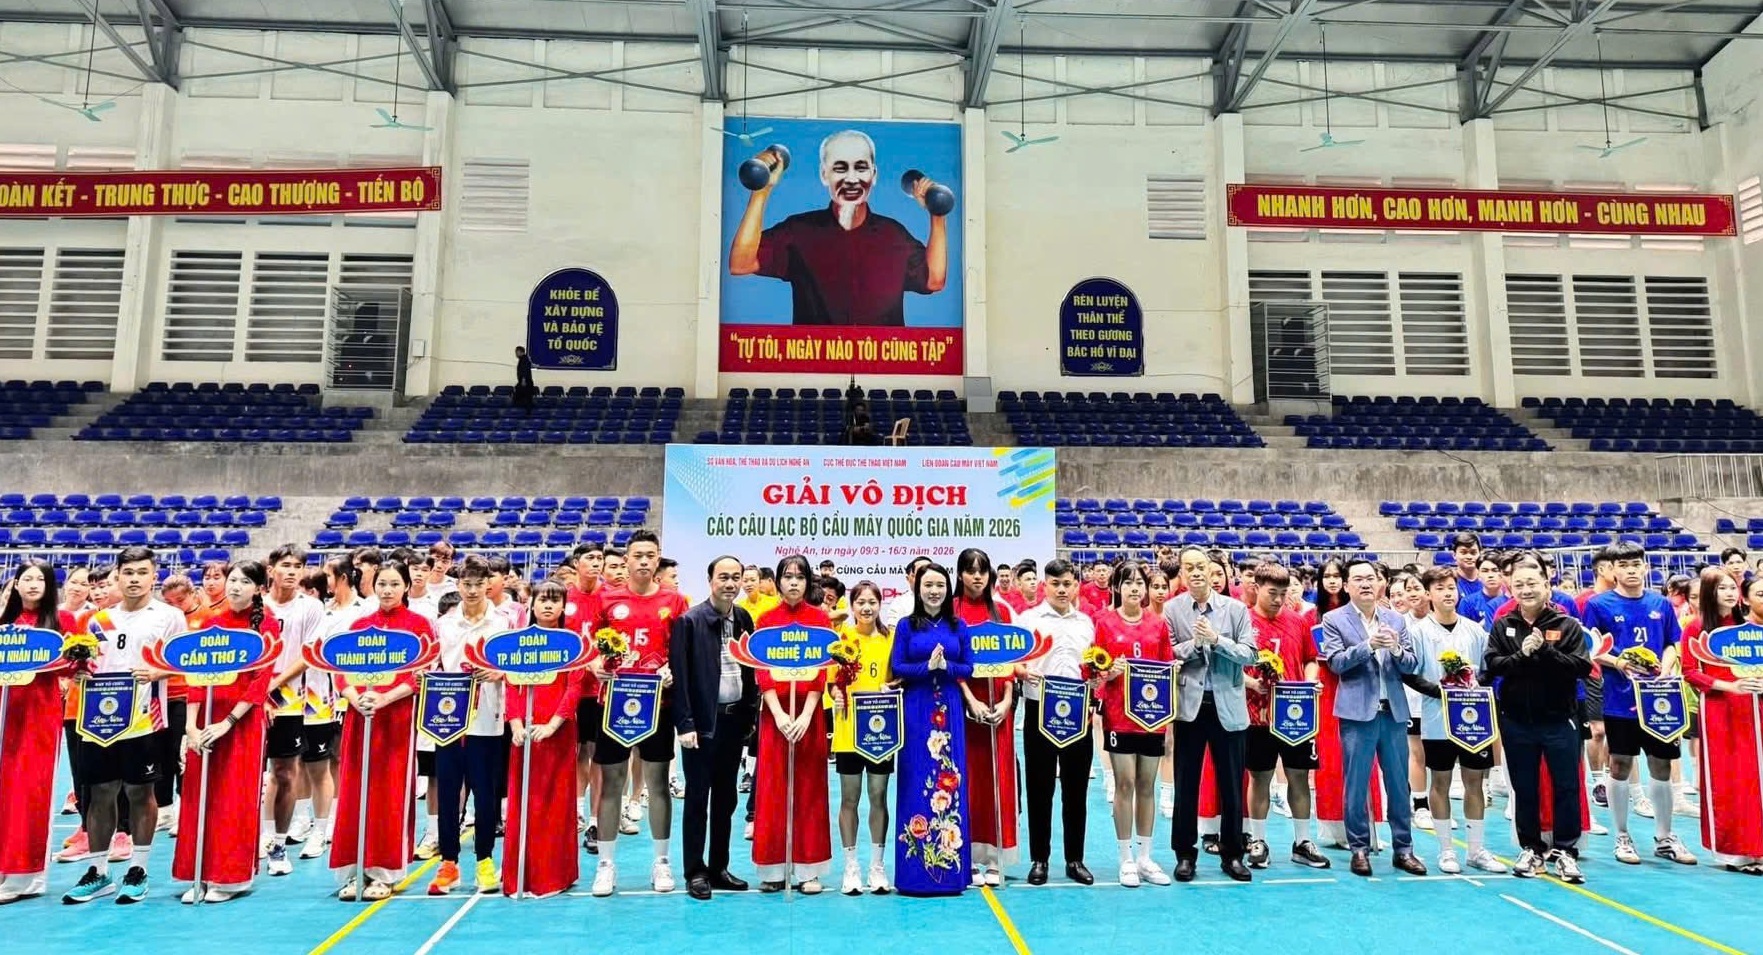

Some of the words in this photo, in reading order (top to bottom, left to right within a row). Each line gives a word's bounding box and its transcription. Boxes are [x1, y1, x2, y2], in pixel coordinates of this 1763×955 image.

[41, 177, 77, 207] KẾT
[94, 183, 155, 207] TRUNG
[161, 180, 210, 210] THỰC
[228, 183, 264, 206] CAO
[269, 179, 340, 209] THƯỢNG
[357, 174, 395, 204] TIẾN
[400, 176, 425, 206] BỘ
[1257, 194, 1325, 218] NHANH
[1332, 193, 1377, 221] HƠN,
[1383, 197, 1421, 220] CAO
[1428, 195, 1473, 223] HƠN,
[1478, 199, 1534, 226] MẠNH
[1539, 198, 1579, 224] HƠN
[1597, 200, 1649, 225] CÙNG
[1655, 203, 1706, 226] NHAU
[550, 286, 580, 300] KHỎE
[1096, 294, 1128, 309] LUYỆN
[544, 304, 567, 317] XÂY
[1077, 311, 1103, 323] THÂN
[543, 320, 558, 333] VÀ
[562, 319, 585, 333] BẢO
[589, 321, 604, 336] VỆ
[1070, 329, 1095, 340] THEO
[1098, 329, 1133, 341] GƯƠNG
[566, 336, 598, 351] QUỐC
[758, 335, 782, 361] TÔI,
[786, 335, 821, 361] NGÀY
[826, 336, 853, 361] NÀO
[857, 336, 877, 361] TÔI
[882, 336, 917, 361] CŨNG
[1067, 344, 1087, 357] BÁC
[1119, 348, 1136, 361] ĐẠI
[763, 476, 830, 505] GIẢI
[840, 479, 883, 505] VÔ
[893, 485, 967, 511] ĐỊCH
[707, 513, 734, 536] CÁC
[739, 513, 766, 536] CÂU
[770, 517, 796, 541] LẠC
[800, 513, 818, 541] BỘ
[822, 510, 849, 536] CẦU
[854, 513, 882, 537] MÂY
[887, 510, 923, 539] QUỐC
[928, 518, 949, 537] GIA
[954, 514, 984, 537] NĂM
[989, 518, 1021, 537] 2026
[775, 546, 801, 558] Nghệ
[802, 547, 819, 557] An,
[821, 546, 833, 556] từ
[835, 546, 856, 558] ngày
[860, 546, 879, 556] 09/3
[889, 546, 907, 556] 16/3
[910, 546, 931, 556] năm
[933, 546, 955, 556] 2026
[836, 564, 863, 575] CÙNG
[867, 562, 886, 575] CẦU
[0, 632, 27, 645] OÀN
[117, 634, 127, 649] 8
[200, 633, 229, 648] ĐOÀN
[358, 633, 386, 647] ĐOÀN
[519, 633, 548, 647] ĐOÀN
[781, 629, 809, 642] ĐOÀN
[1633, 627, 1648, 642] 21
[971, 635, 1000, 654] ỌNG
[1003, 632, 1026, 650] TÀI
[1132, 642, 1141, 658] 6
[1270, 638, 1281, 654] 7
[211, 649, 236, 664] THƠ
[239, 650, 247, 663] 2
[335, 650, 365, 665] THÀNH
[368, 648, 387, 664] PHỐ
[389, 648, 407, 664] HUẾ
[497, 653, 508, 666] TP.
[524, 648, 537, 664] CHÍ
[539, 651, 561, 664] MINH
[563, 650, 569, 663] 3
[766, 645, 800, 662] NGHỆ
[804, 646, 822, 659] AN
[869, 662, 878, 678] 6
[1110, 731, 1118, 747] 6
